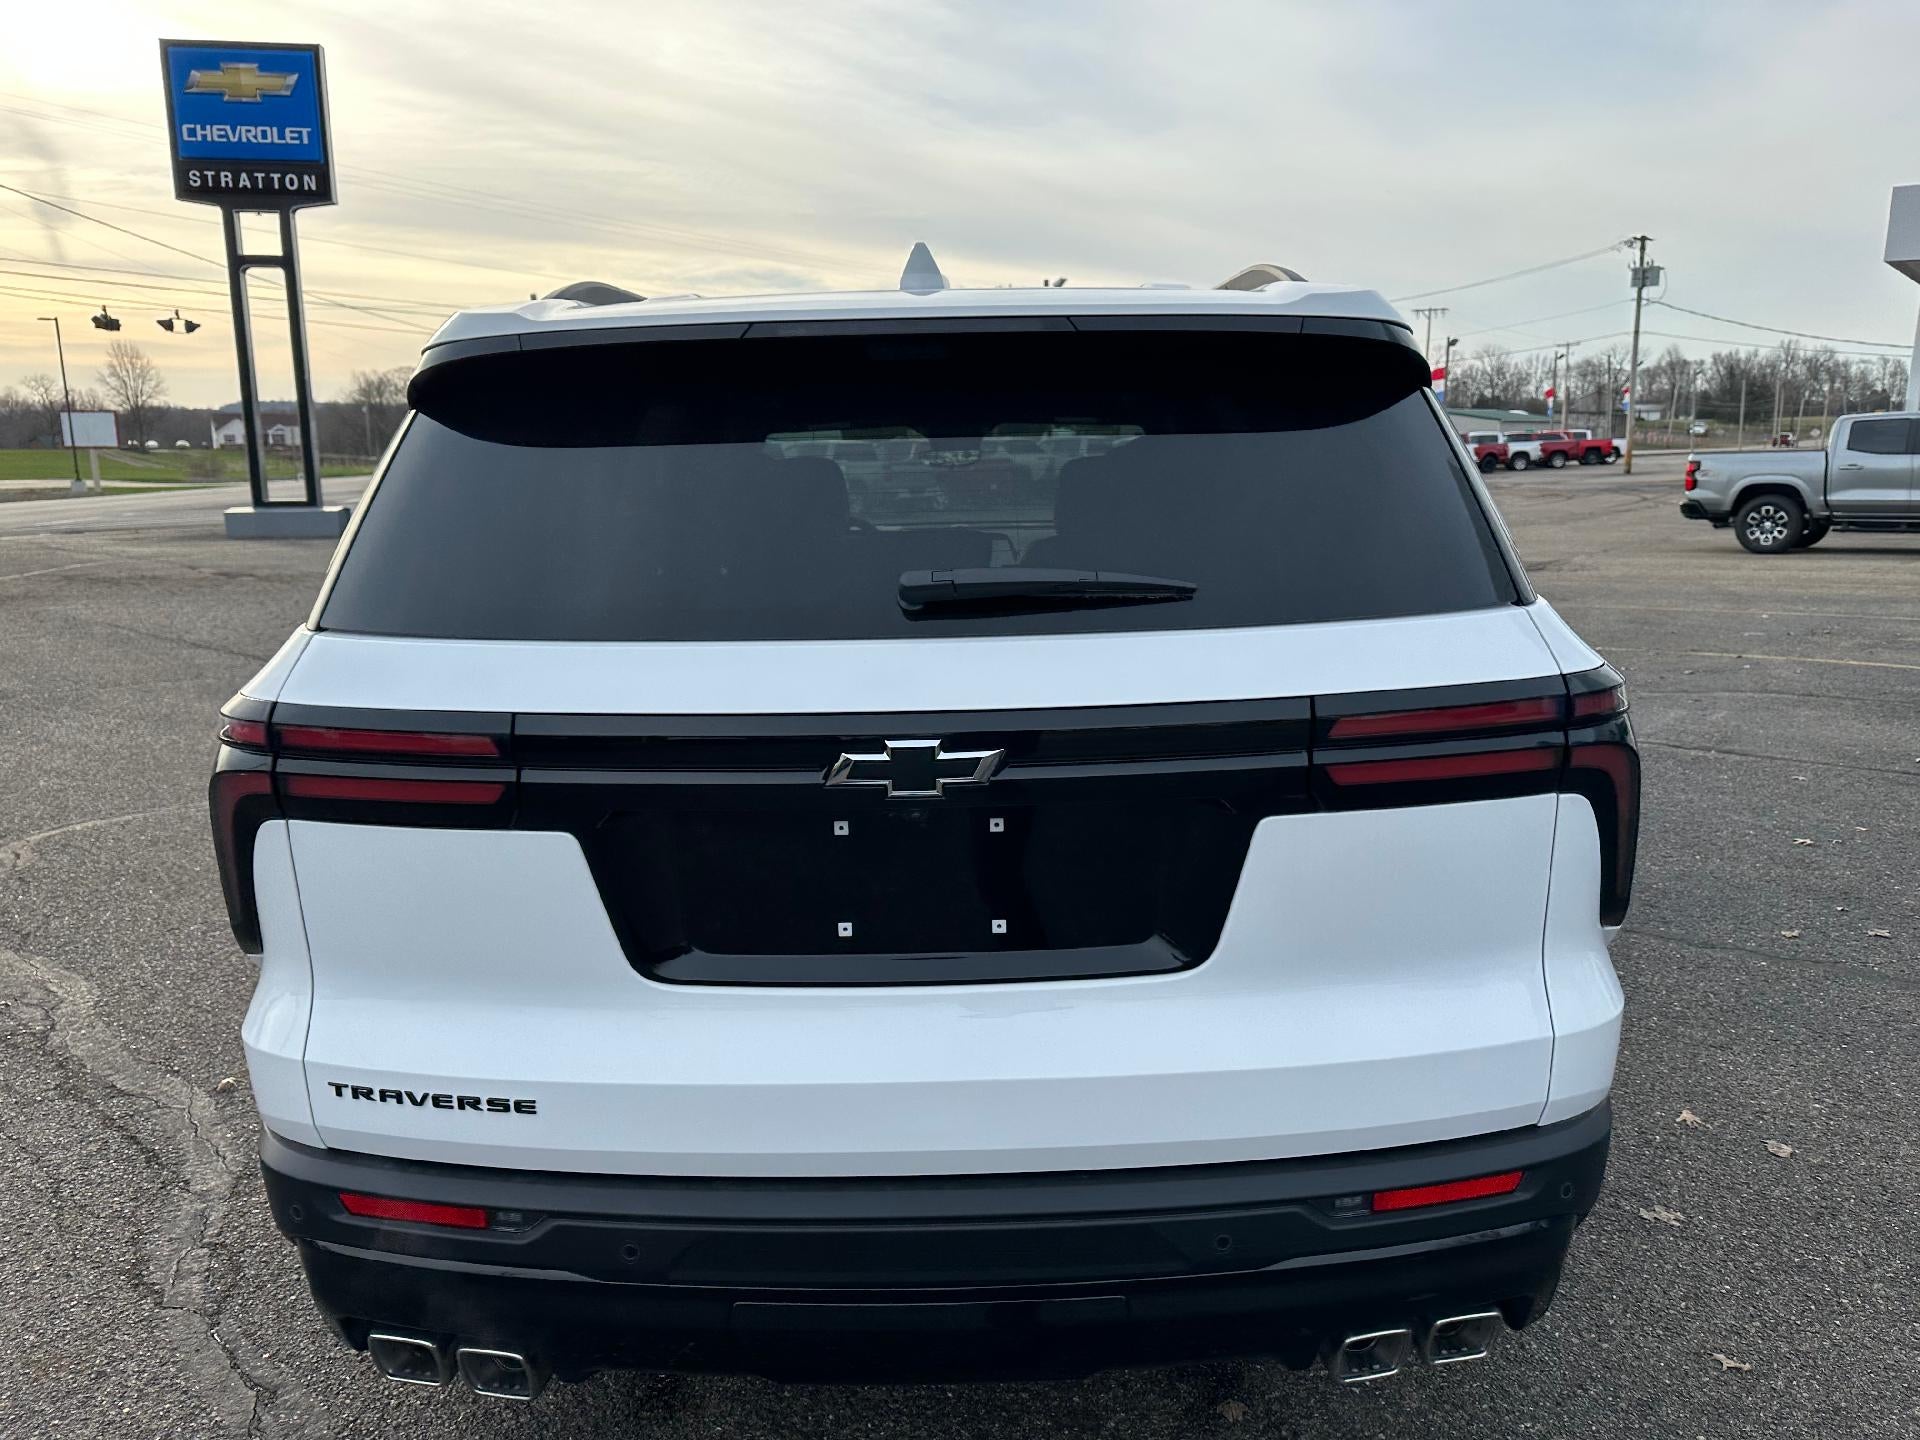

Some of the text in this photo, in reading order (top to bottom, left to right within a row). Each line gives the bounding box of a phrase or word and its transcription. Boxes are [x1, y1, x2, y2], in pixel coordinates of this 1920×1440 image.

[181, 123, 312, 145] CHEVROLET
[188, 169, 318, 191] STRATTON
[327, 1081, 538, 1115] TRAVERSE
